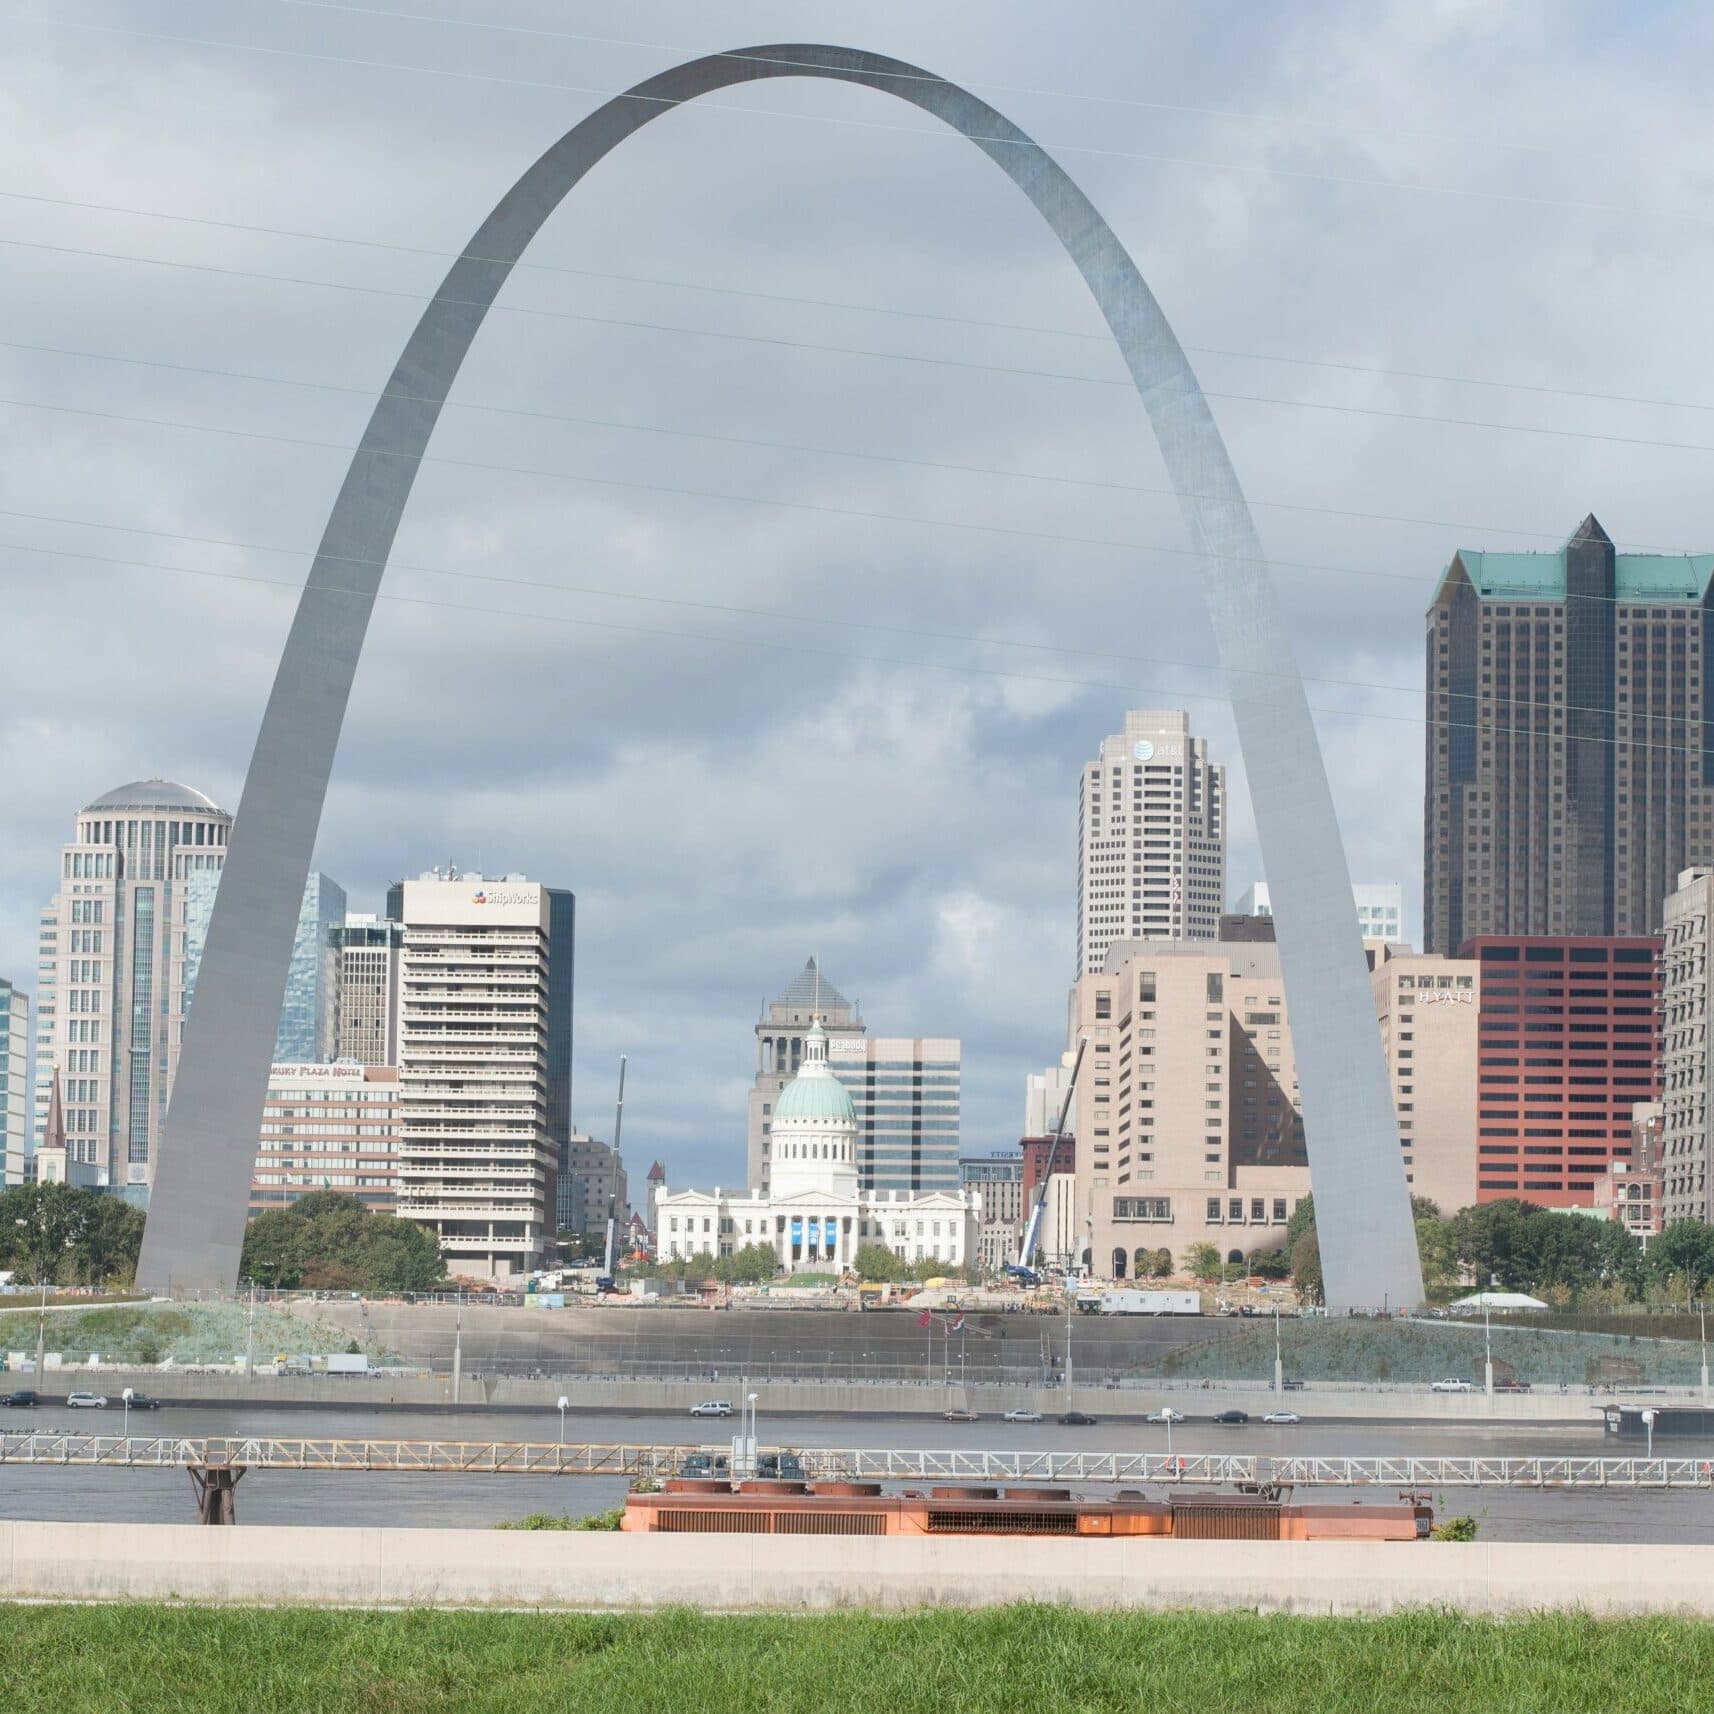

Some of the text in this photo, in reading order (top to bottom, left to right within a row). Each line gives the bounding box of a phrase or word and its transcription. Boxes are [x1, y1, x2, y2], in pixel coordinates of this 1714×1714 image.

[488, 891, 539, 907] ShipWorks
[1419, 991, 1476, 1005] HYATT
[830, 1039, 866, 1051] Peabody
[271, 1067, 297, 1076] RURY
[333, 1066, 361, 1077] HOTEL
